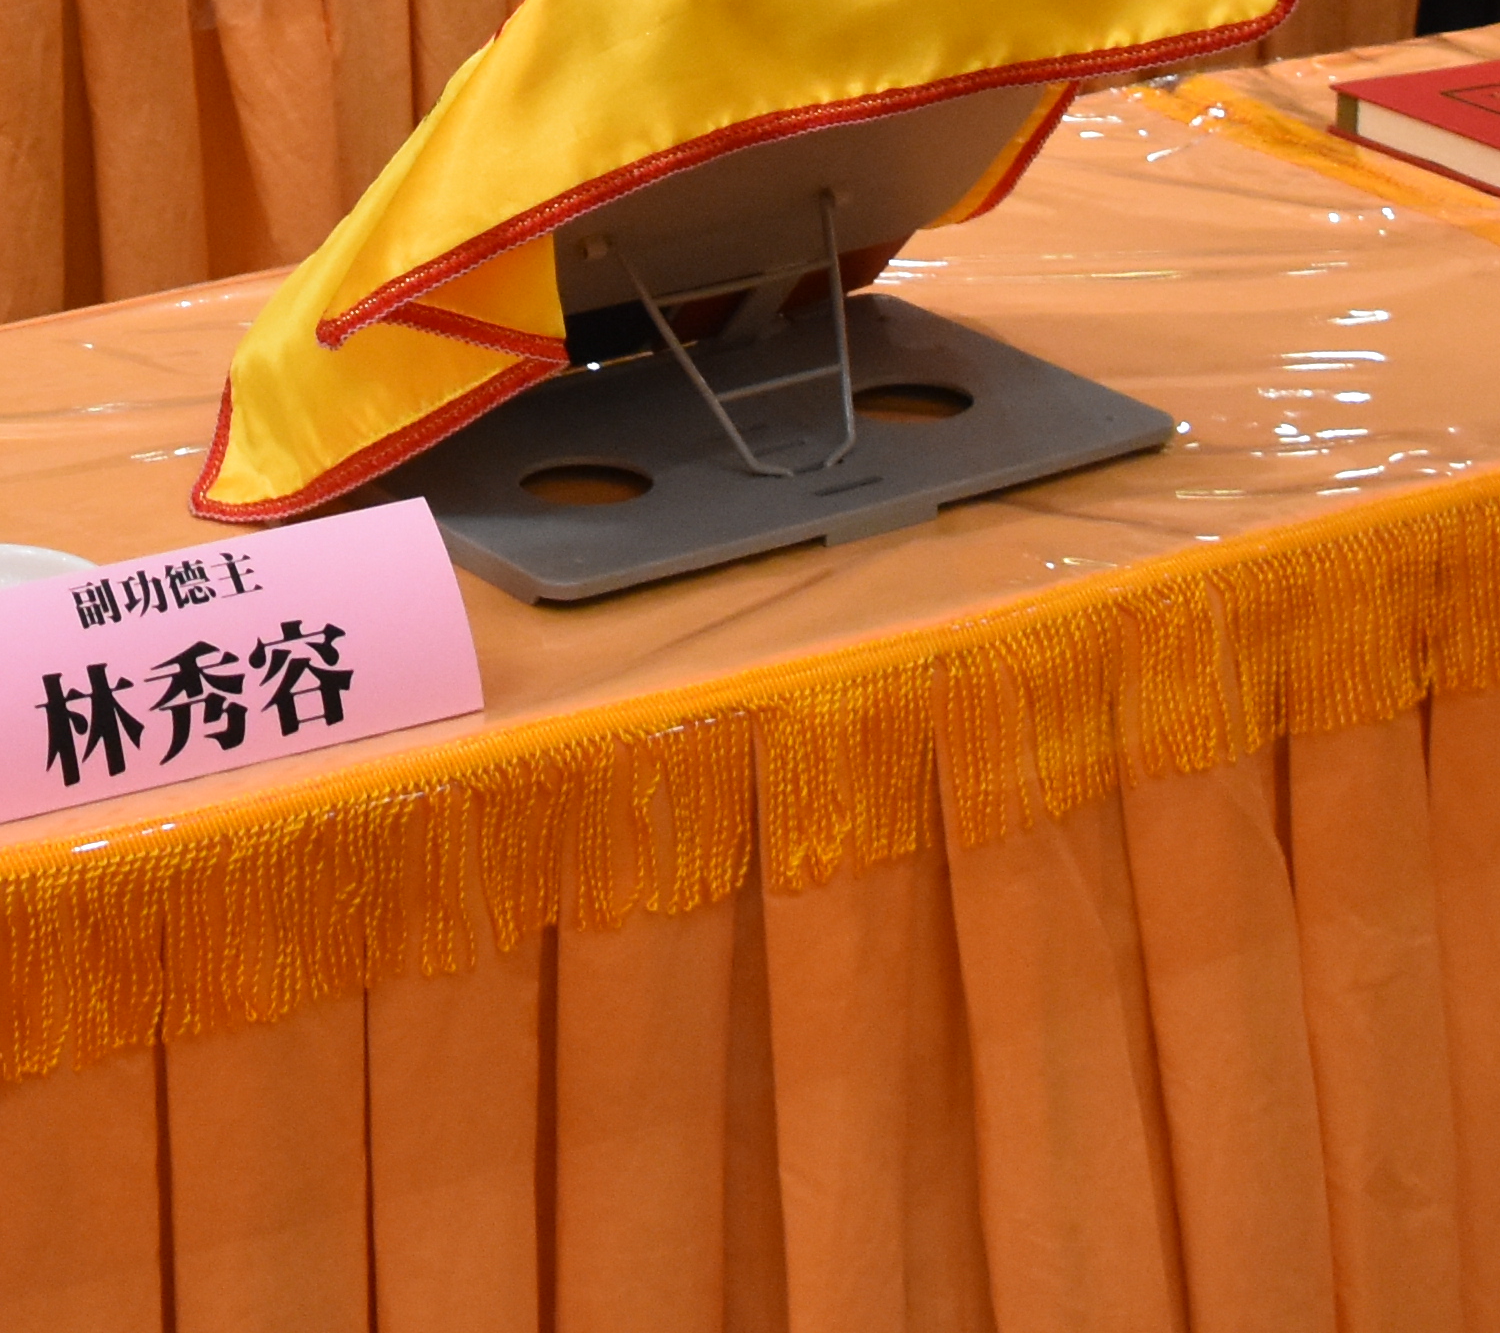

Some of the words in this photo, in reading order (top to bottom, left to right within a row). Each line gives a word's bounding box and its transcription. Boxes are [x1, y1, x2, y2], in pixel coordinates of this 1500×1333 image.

[69, 552, 264, 630] 副功德主
[34, 619, 354, 787] 林秀容
